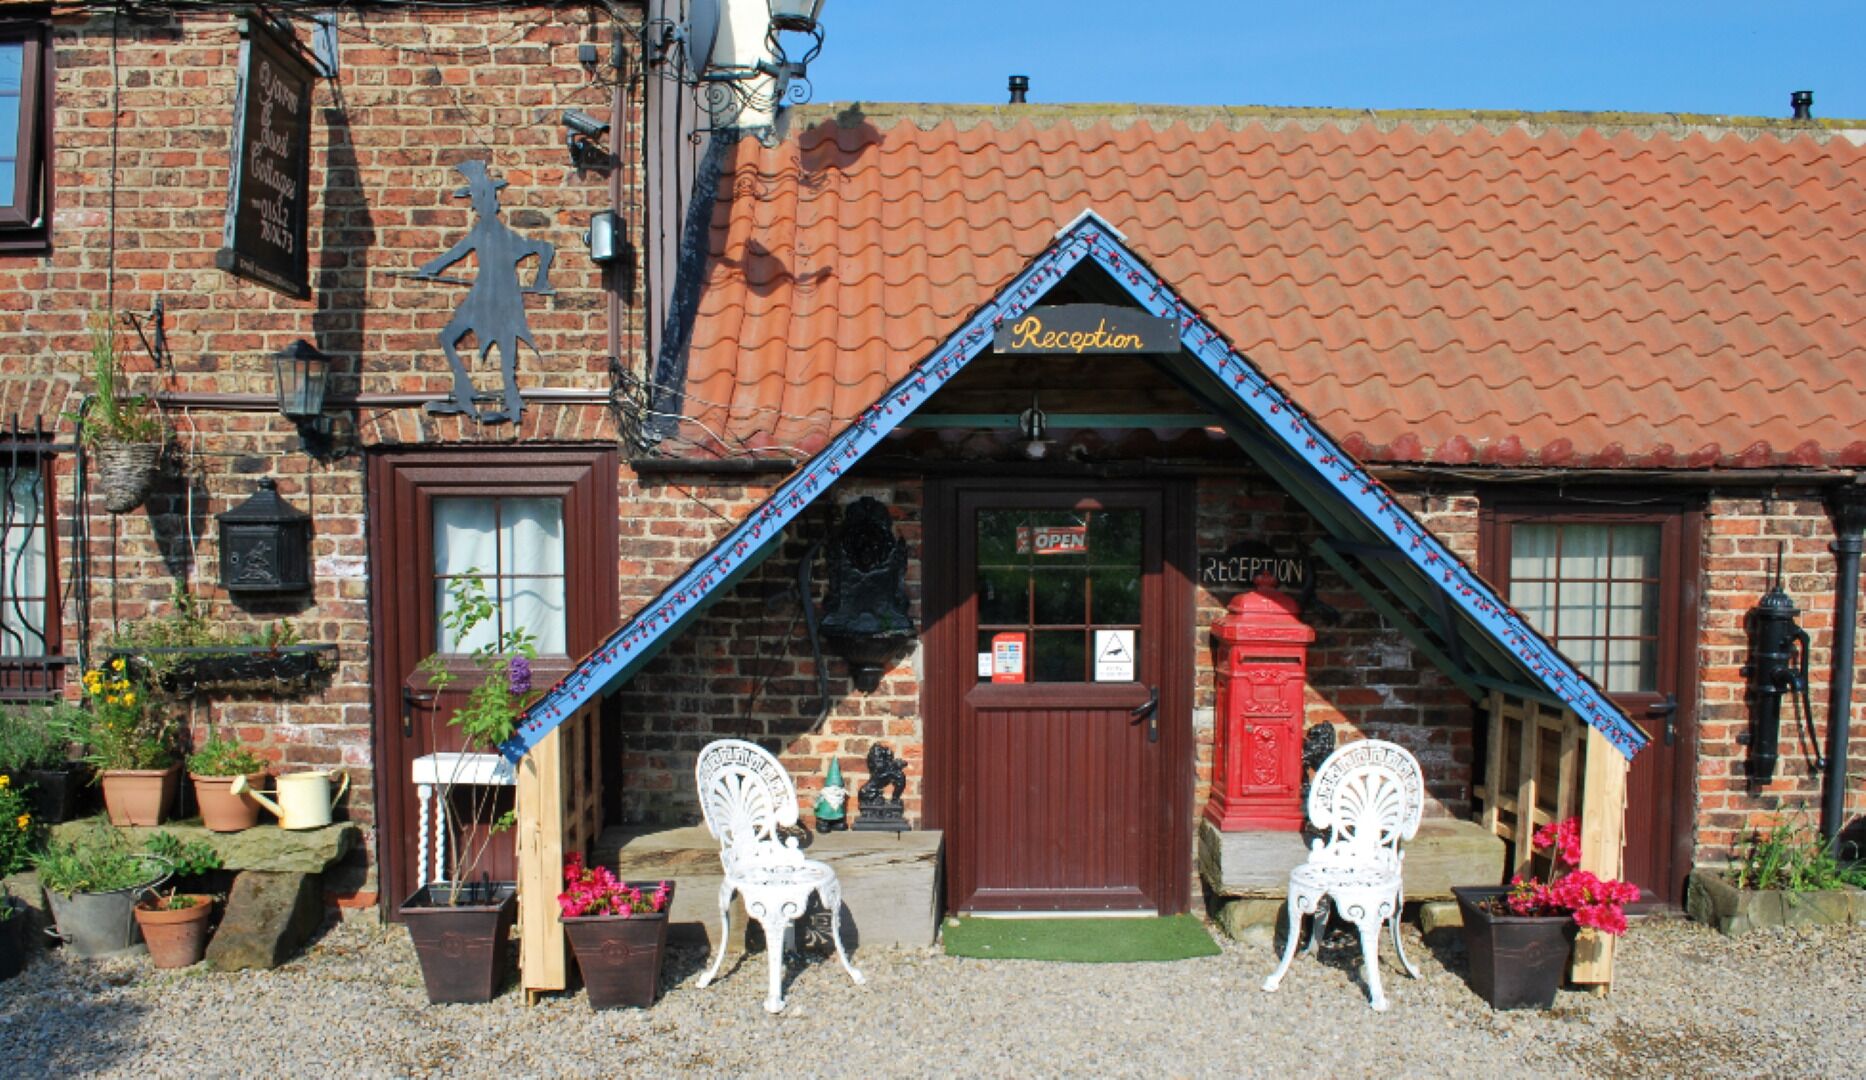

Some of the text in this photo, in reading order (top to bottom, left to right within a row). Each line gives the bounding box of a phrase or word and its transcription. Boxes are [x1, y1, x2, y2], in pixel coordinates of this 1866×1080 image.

[251, 140, 297, 205] Cottages
[1012, 316, 1144, 353] Reception
[1035, 533, 1085, 549] OPEN
[1203, 556, 1303, 583] RECEPTION
